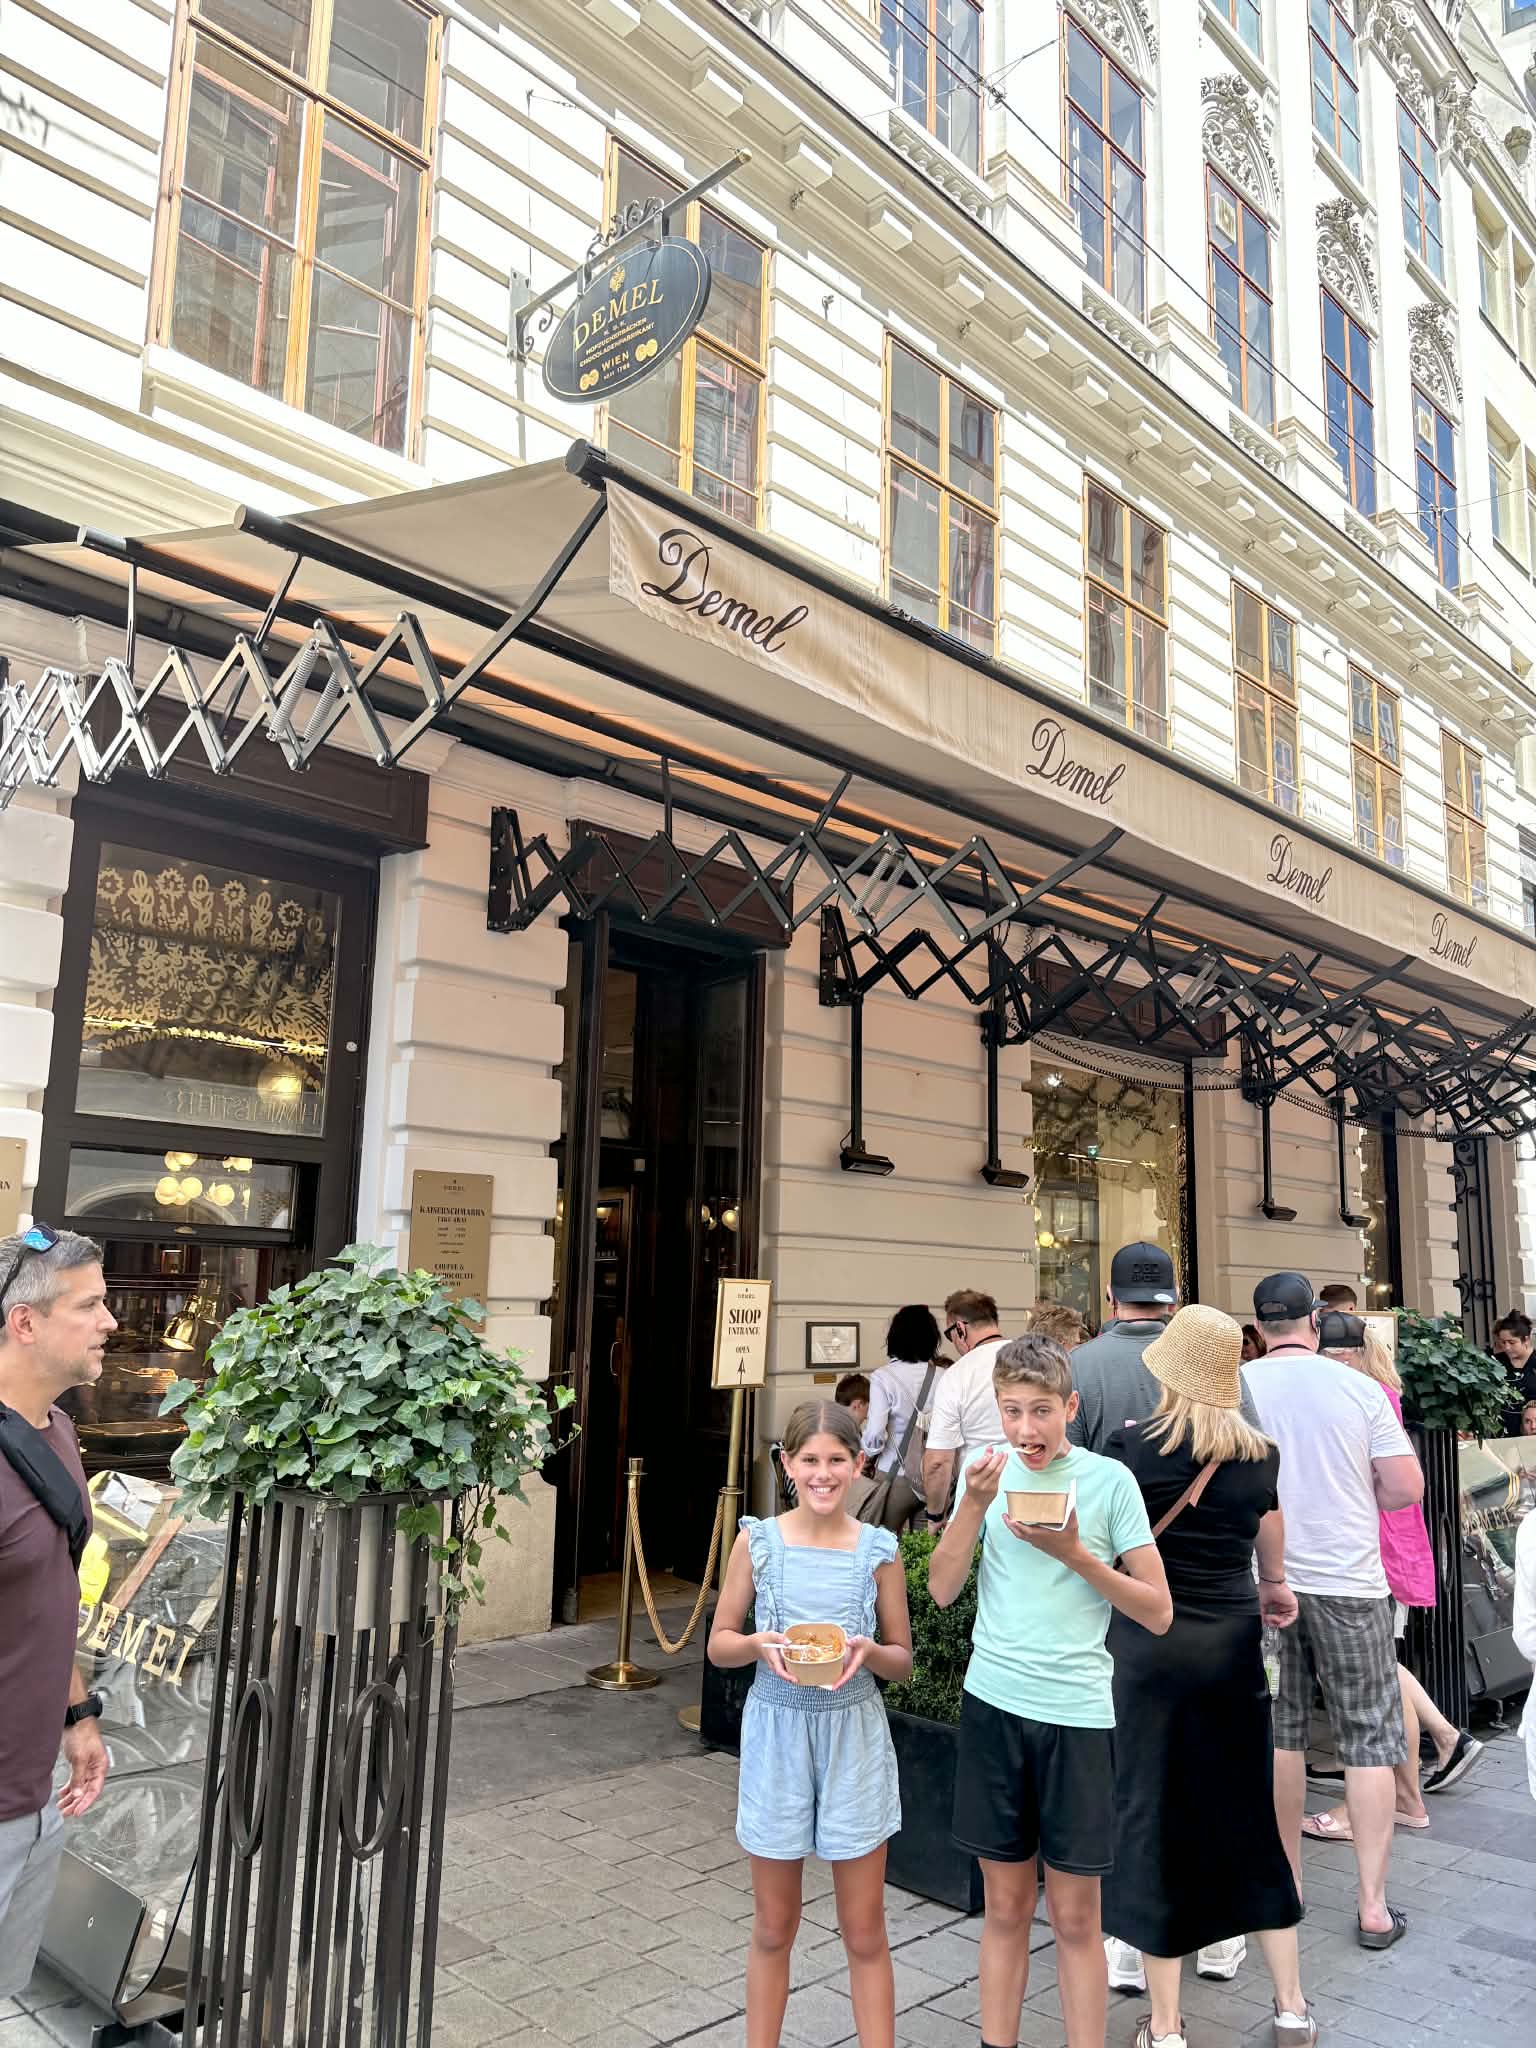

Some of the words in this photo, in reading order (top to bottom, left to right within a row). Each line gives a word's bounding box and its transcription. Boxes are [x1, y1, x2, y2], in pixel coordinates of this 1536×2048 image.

[573, 279, 664, 352] DEMEL
[601, 351, 629, 371] WIEN
[640, 528, 809, 653] Demel
[1025, 718, 1126, 805] Demel
[1267, 833, 1333, 903] Demel
[1429, 912, 1478, 969] Demel
[728, 1308, 761, 1325] SHOP
[728, 1326, 761, 1336] ENTRANCE
[735, 1345, 750, 1353] OPEN
